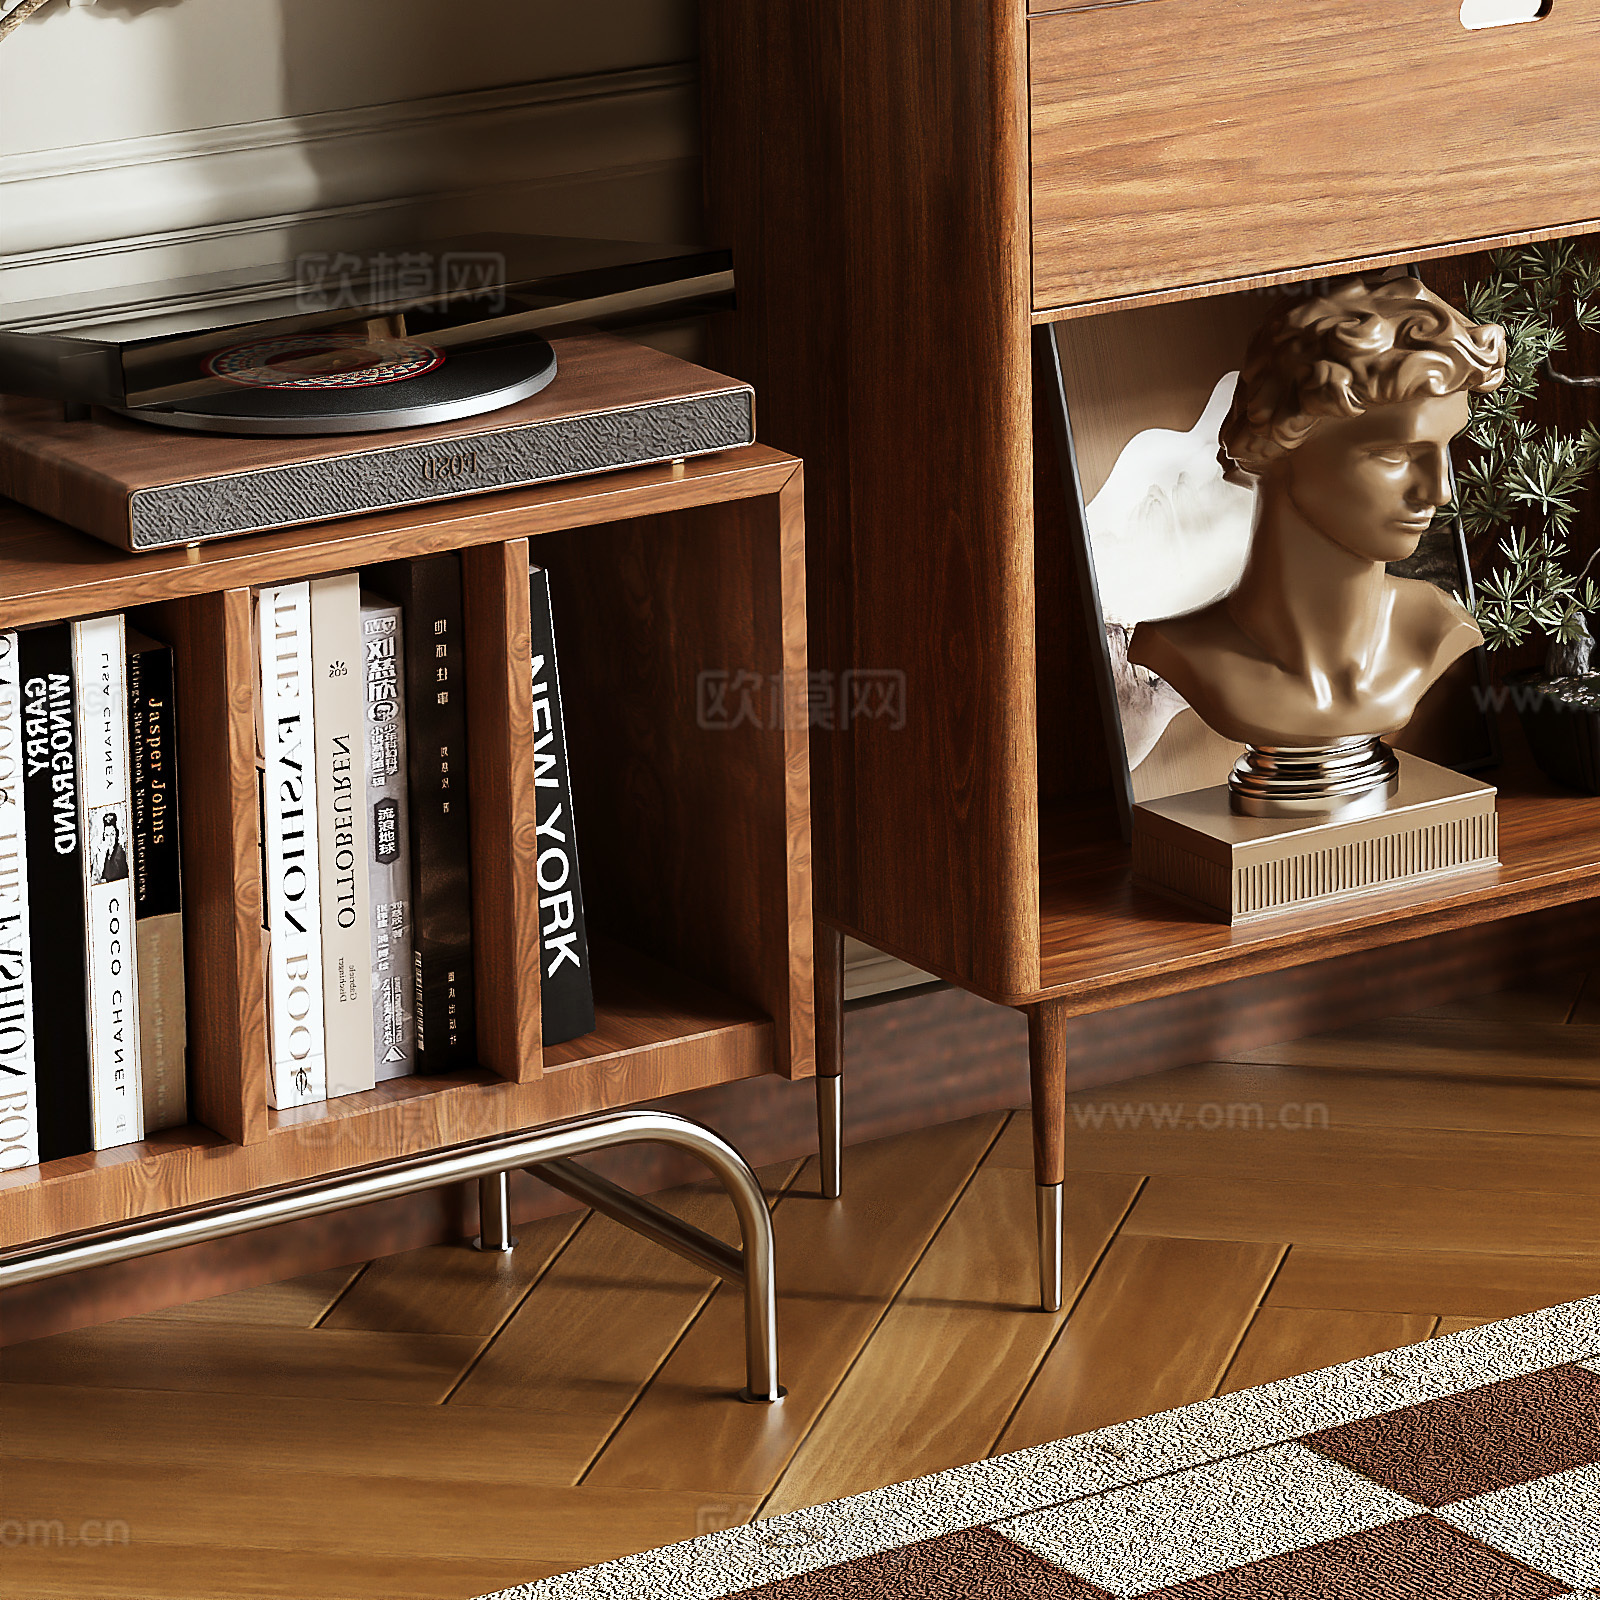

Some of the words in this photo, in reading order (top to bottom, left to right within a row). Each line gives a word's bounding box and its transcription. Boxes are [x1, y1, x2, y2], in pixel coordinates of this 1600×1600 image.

[366, 636, 397, 703] 刘慈欣
[133, 711, 145, 784] Sketchbook
[146, 697, 163, 772] Jasper
[530, 654, 560, 789] NEW
[151, 779, 168, 846] Johns
[377, 807, 396, 856] 流浪地球
[536, 802, 581, 979] YORK
